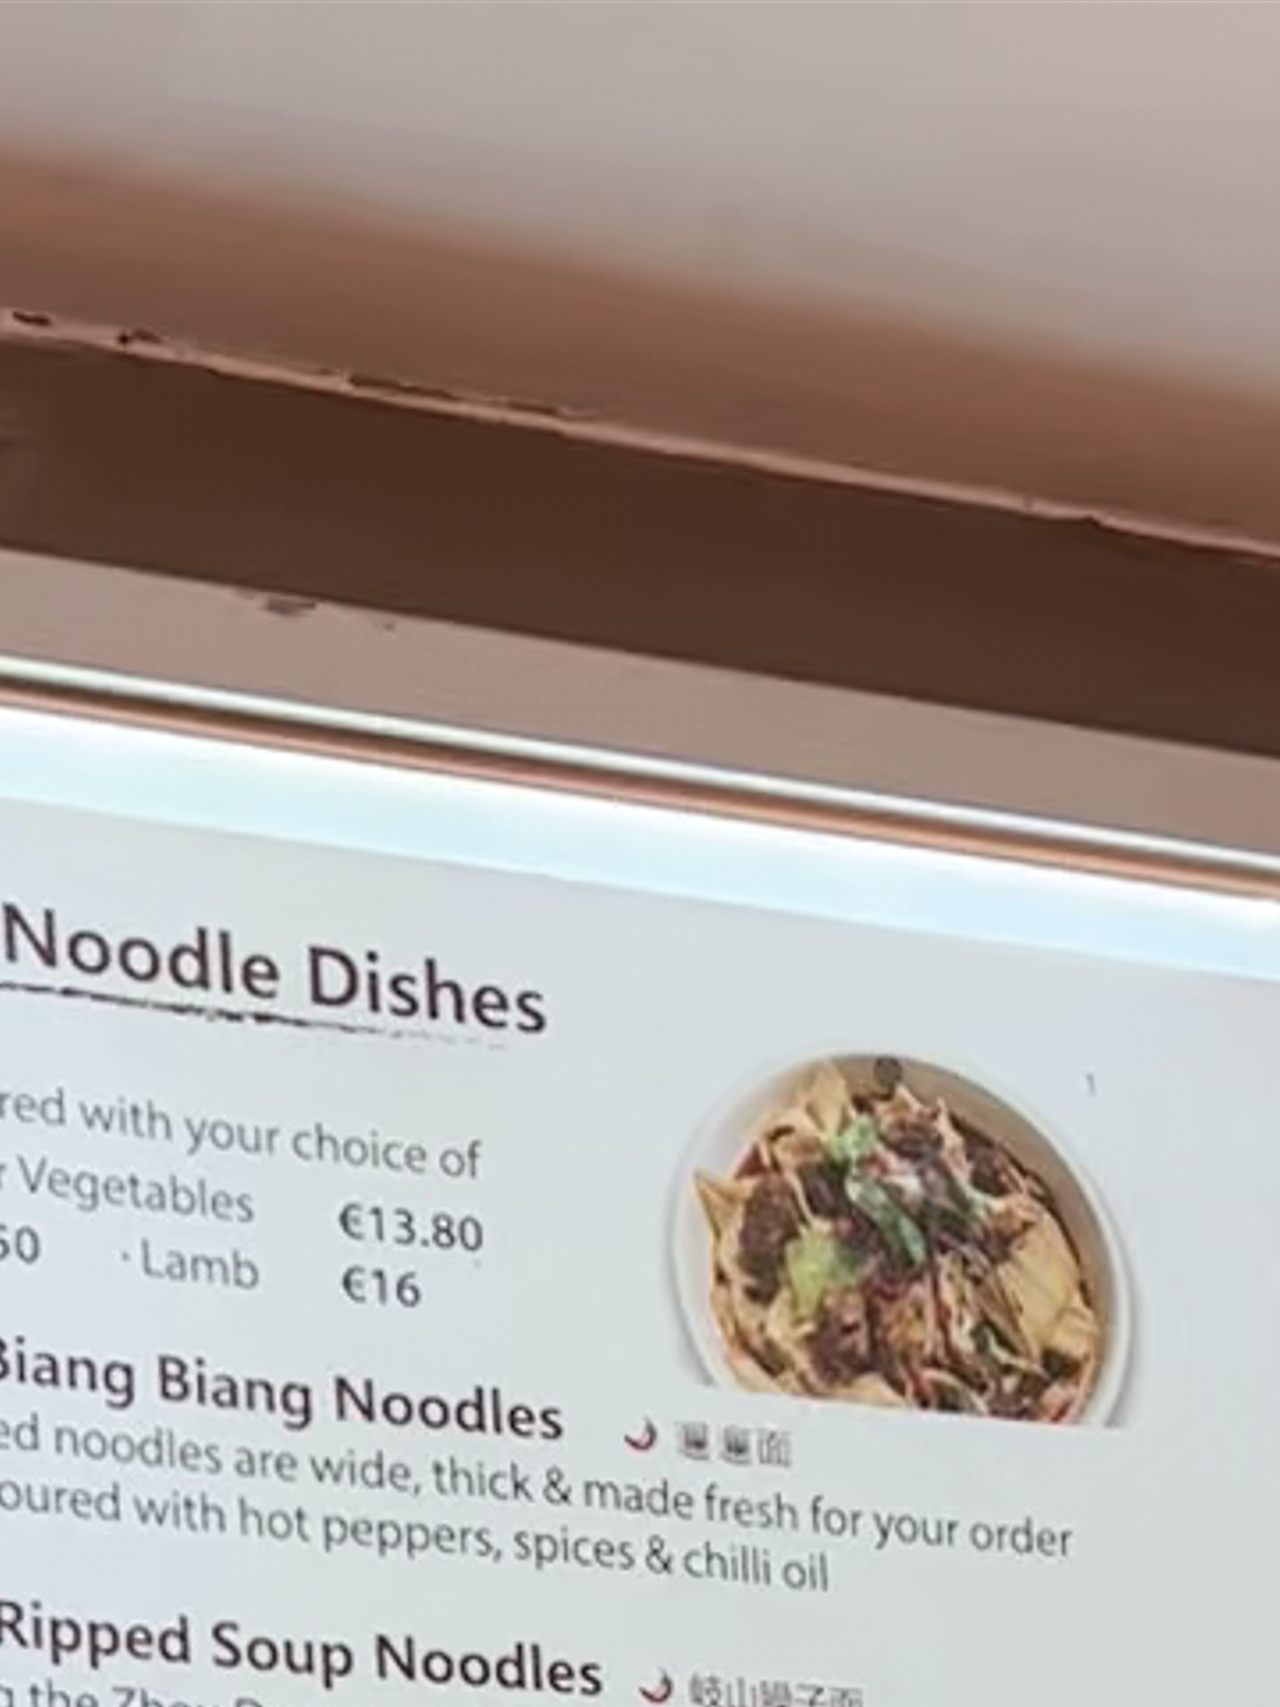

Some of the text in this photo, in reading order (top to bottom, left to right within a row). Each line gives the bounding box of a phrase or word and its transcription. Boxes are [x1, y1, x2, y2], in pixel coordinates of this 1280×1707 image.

[3, 903, 279, 999] Noodle
[310, 948, 547, 1033] Dishes
[78, 1097, 172, 1140] with
[184, 1118, 279, 1155] your
[291, 1122, 427, 1174] choice
[439, 1139, 481, 1179] of
[16, 1154, 254, 1222] Vegetables
[337, 1201, 483, 1252] €13.80
[140, 1237, 422, 1308] Lamb €16
[157, 1353, 313, 1432] Biang
[333, 1373, 564, 1441] Noodles
[211, 1619, 354, 1691] Soup
[374, 1632, 603, 1697] Noodles
